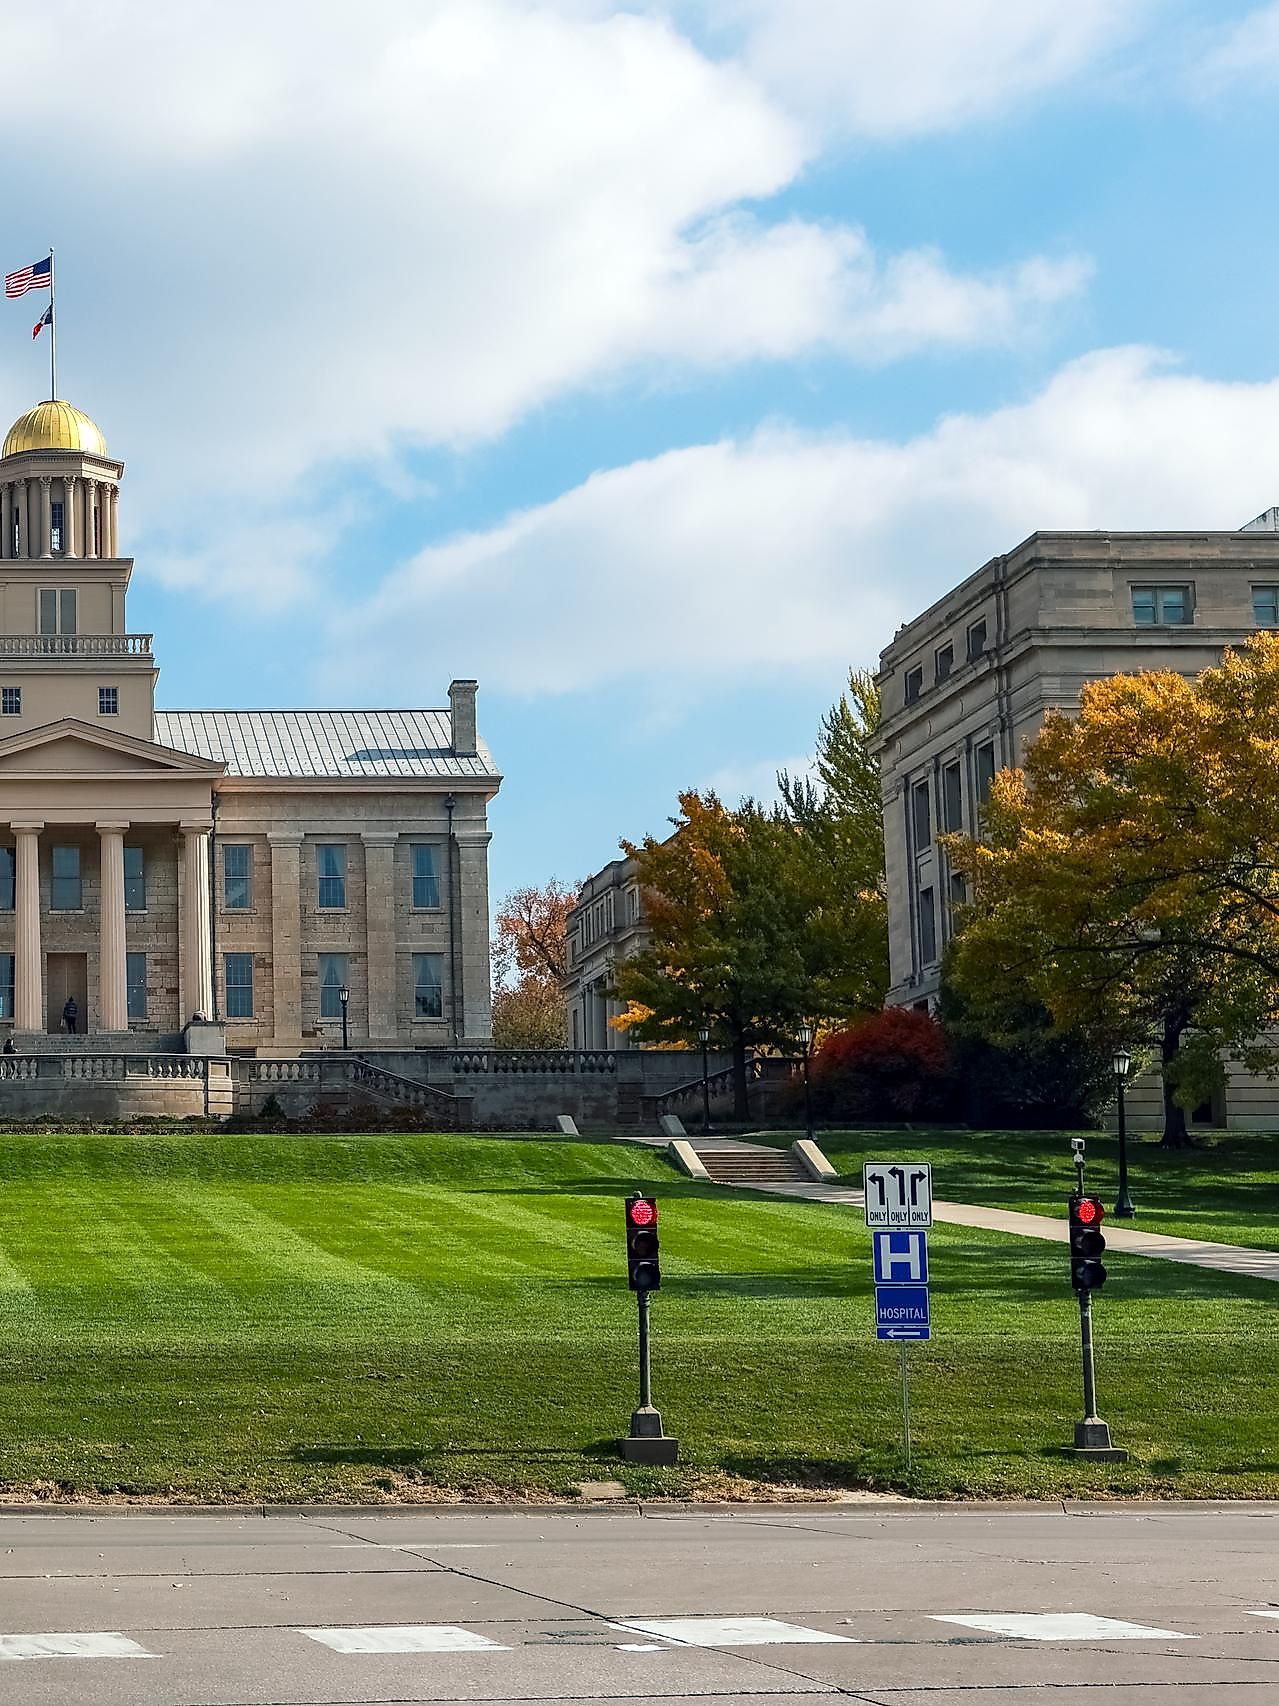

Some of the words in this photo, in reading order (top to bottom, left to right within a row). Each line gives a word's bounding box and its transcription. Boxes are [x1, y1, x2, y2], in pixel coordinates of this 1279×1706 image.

[870, 1211, 886, 1222] ONLY
[891, 1211, 907, 1222] ONLY
[912, 1211, 928, 1222] ONLY
[880, 1234, 921, 1280] H
[879, 1307, 926, 1319] HOSPITAL
